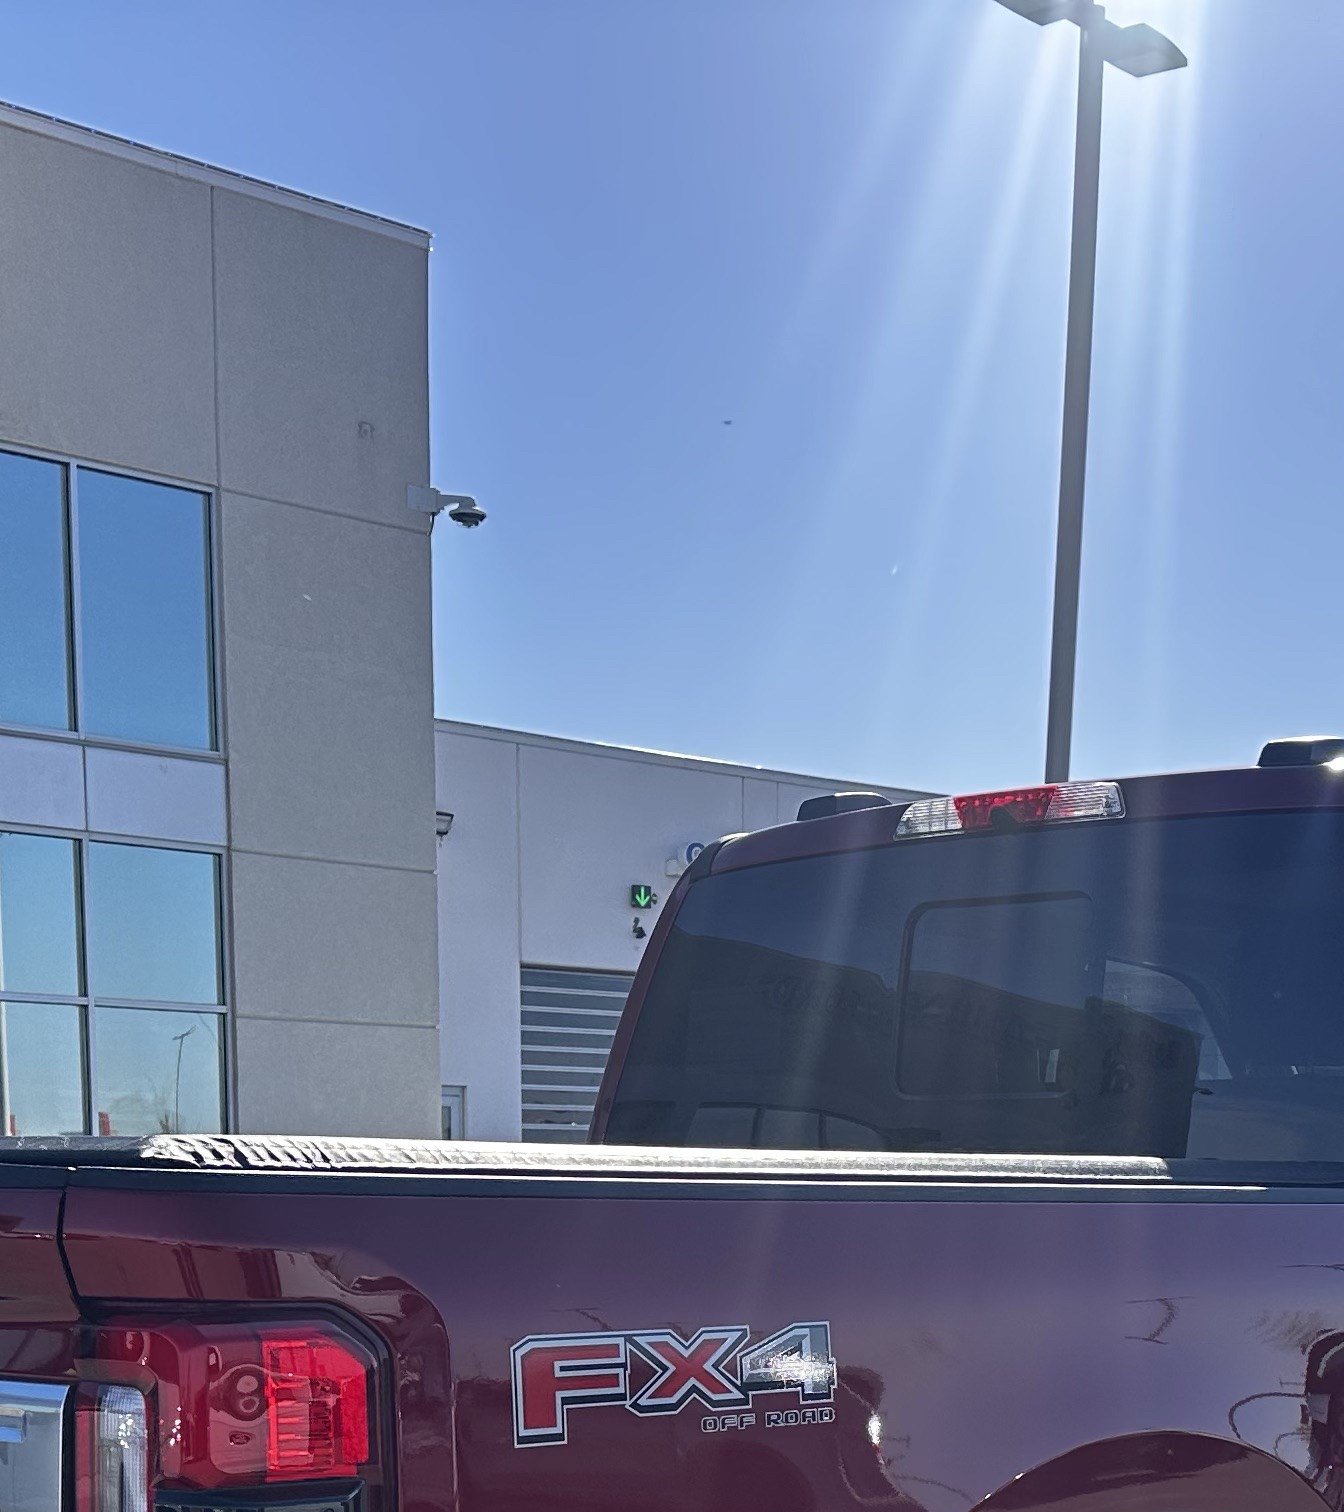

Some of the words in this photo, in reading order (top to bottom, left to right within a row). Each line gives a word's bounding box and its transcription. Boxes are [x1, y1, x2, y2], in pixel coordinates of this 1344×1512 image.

[510, 1320, 837, 1449] FX4
[701, 1412, 757, 1433] OFF
[765, 1407, 836, 1429] ROAD
